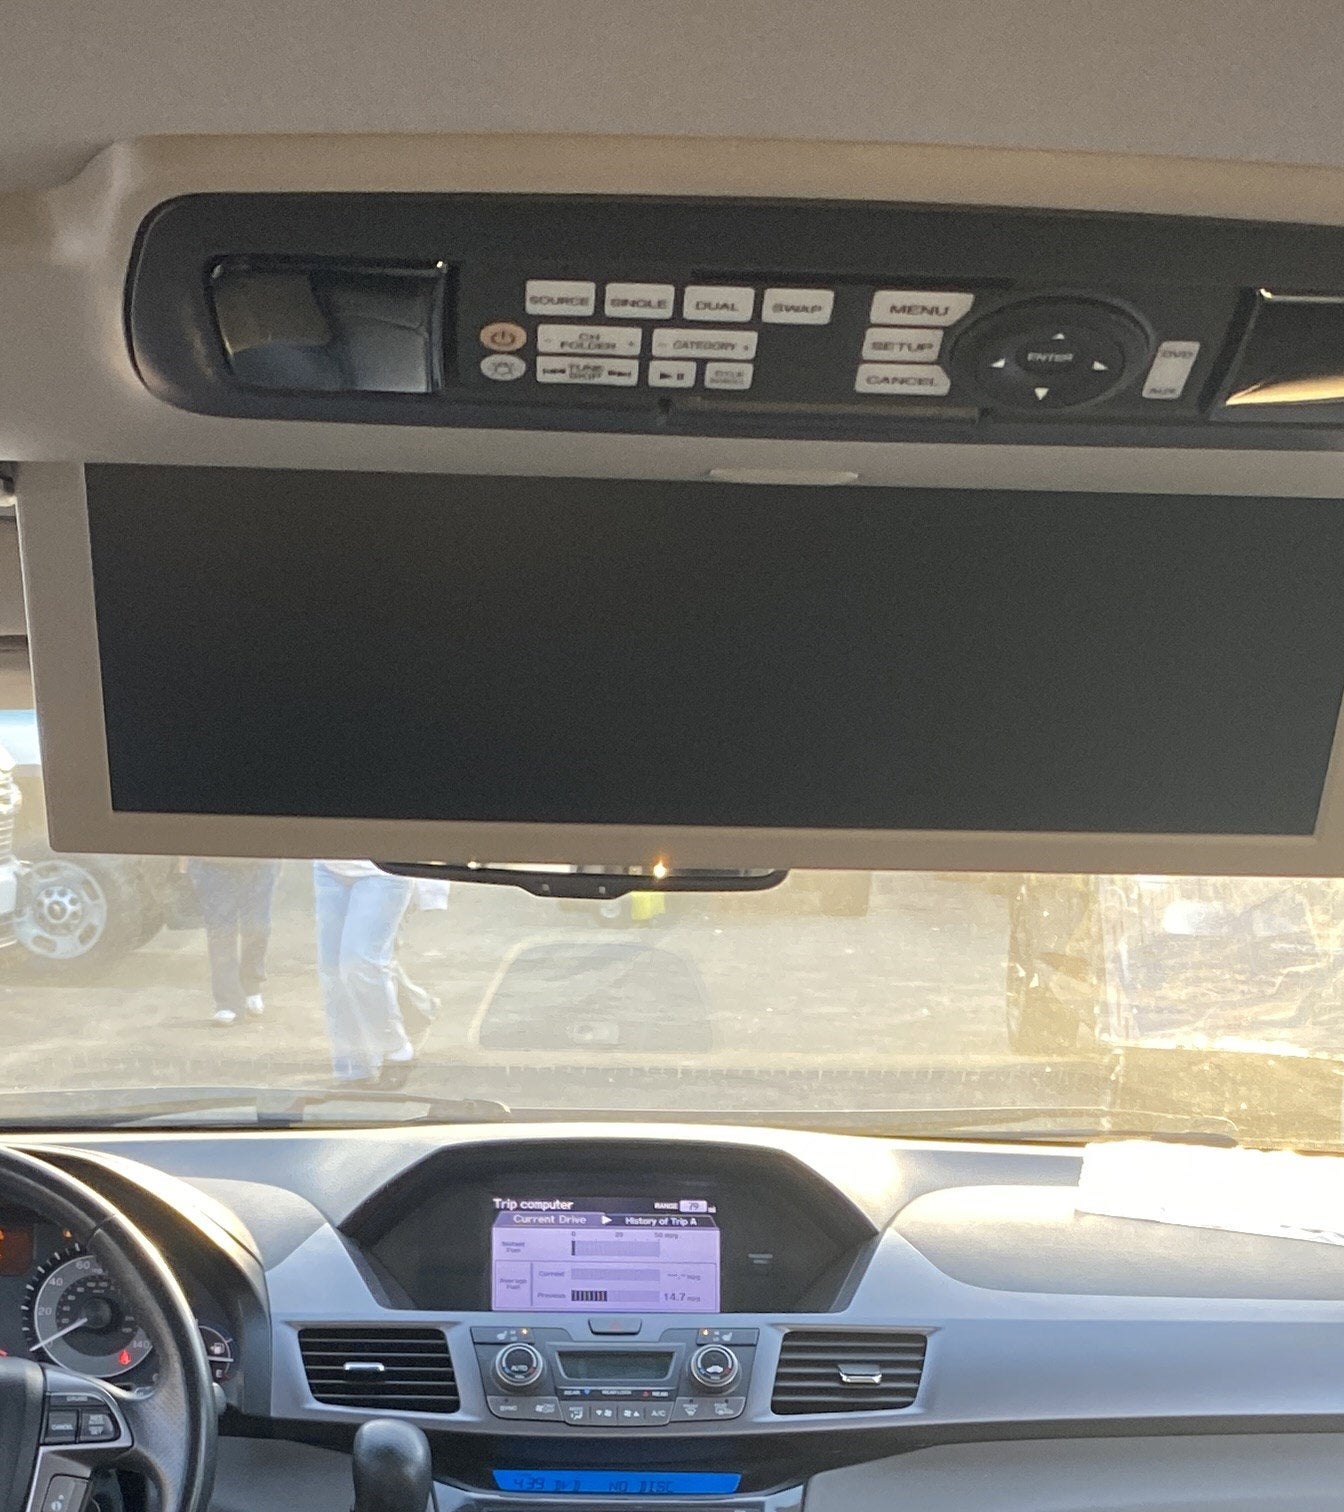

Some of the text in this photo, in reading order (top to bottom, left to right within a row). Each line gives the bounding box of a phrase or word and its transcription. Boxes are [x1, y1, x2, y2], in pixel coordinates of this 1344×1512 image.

[695, 300, 739, 312] DUAL
[771, 302, 823, 314] SWAP
[889, 304, 950, 317] MENU
[672, 339, 736, 351] CATEGORY
[871, 341, 934, 352] SETUP
[1027, 351, 1074, 363] ENTER
[865, 375, 936, 387] CANCEL
[493, 1198, 574, 1211] Trip computer
[654, 1202, 679, 1210] RANGE
[689, 1202, 699, 1211] 79
[513, 1214, 587, 1224] Current Drive
[625, 1217, 698, 1227] History of Trip A
[75, 1260, 91, 1270] 60
[48, 1277, 64, 1287] 40
[664, 1292, 686, 1302] 14.7
[38, 1306, 53, 1316] 20
[133, 1339, 150, 1349] 140
[511, 1364, 528, 1372] AUTO
[608, 1480, 628, 1492] NO
[640, 1480, 674, 1493] DISC
